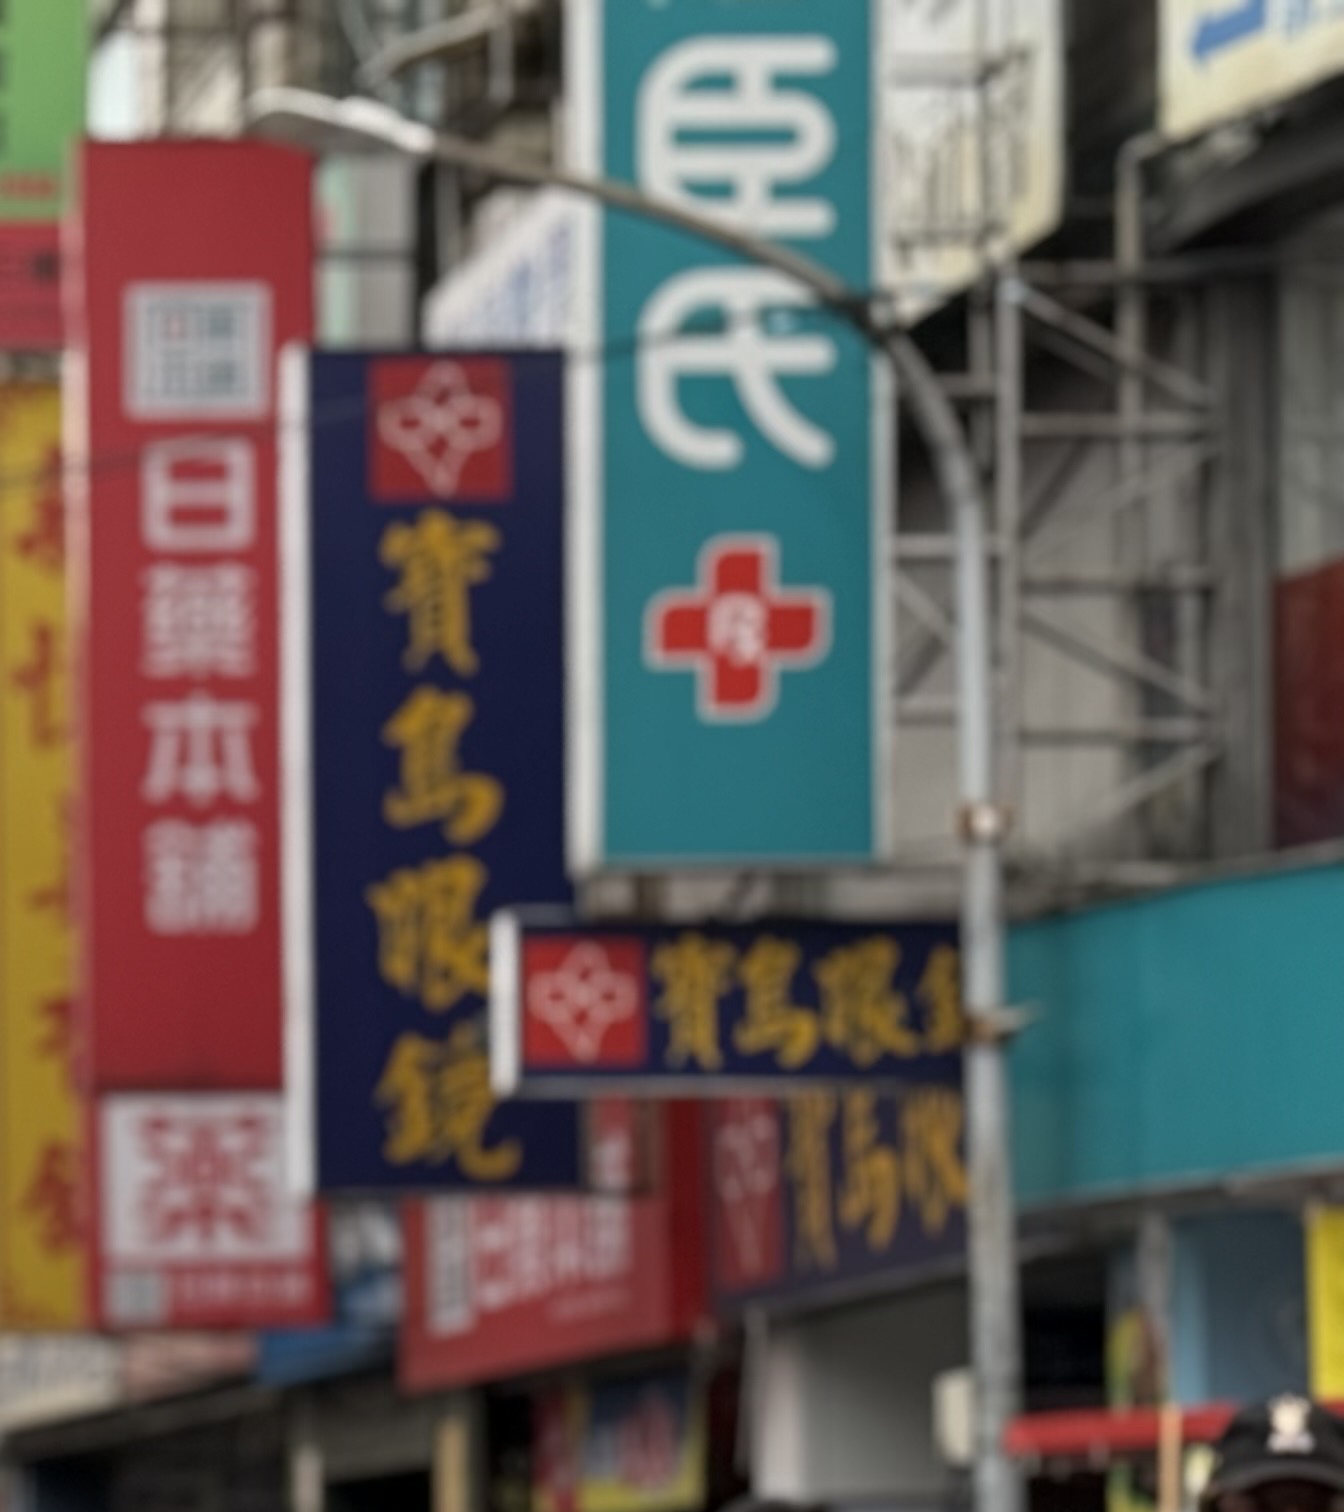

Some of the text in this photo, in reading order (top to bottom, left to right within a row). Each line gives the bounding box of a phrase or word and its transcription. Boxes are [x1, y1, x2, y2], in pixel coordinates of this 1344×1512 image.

[140, 433, 260, 936] 日藥本舖
[366, 506, 523, 1182] 寶島眼鏡
